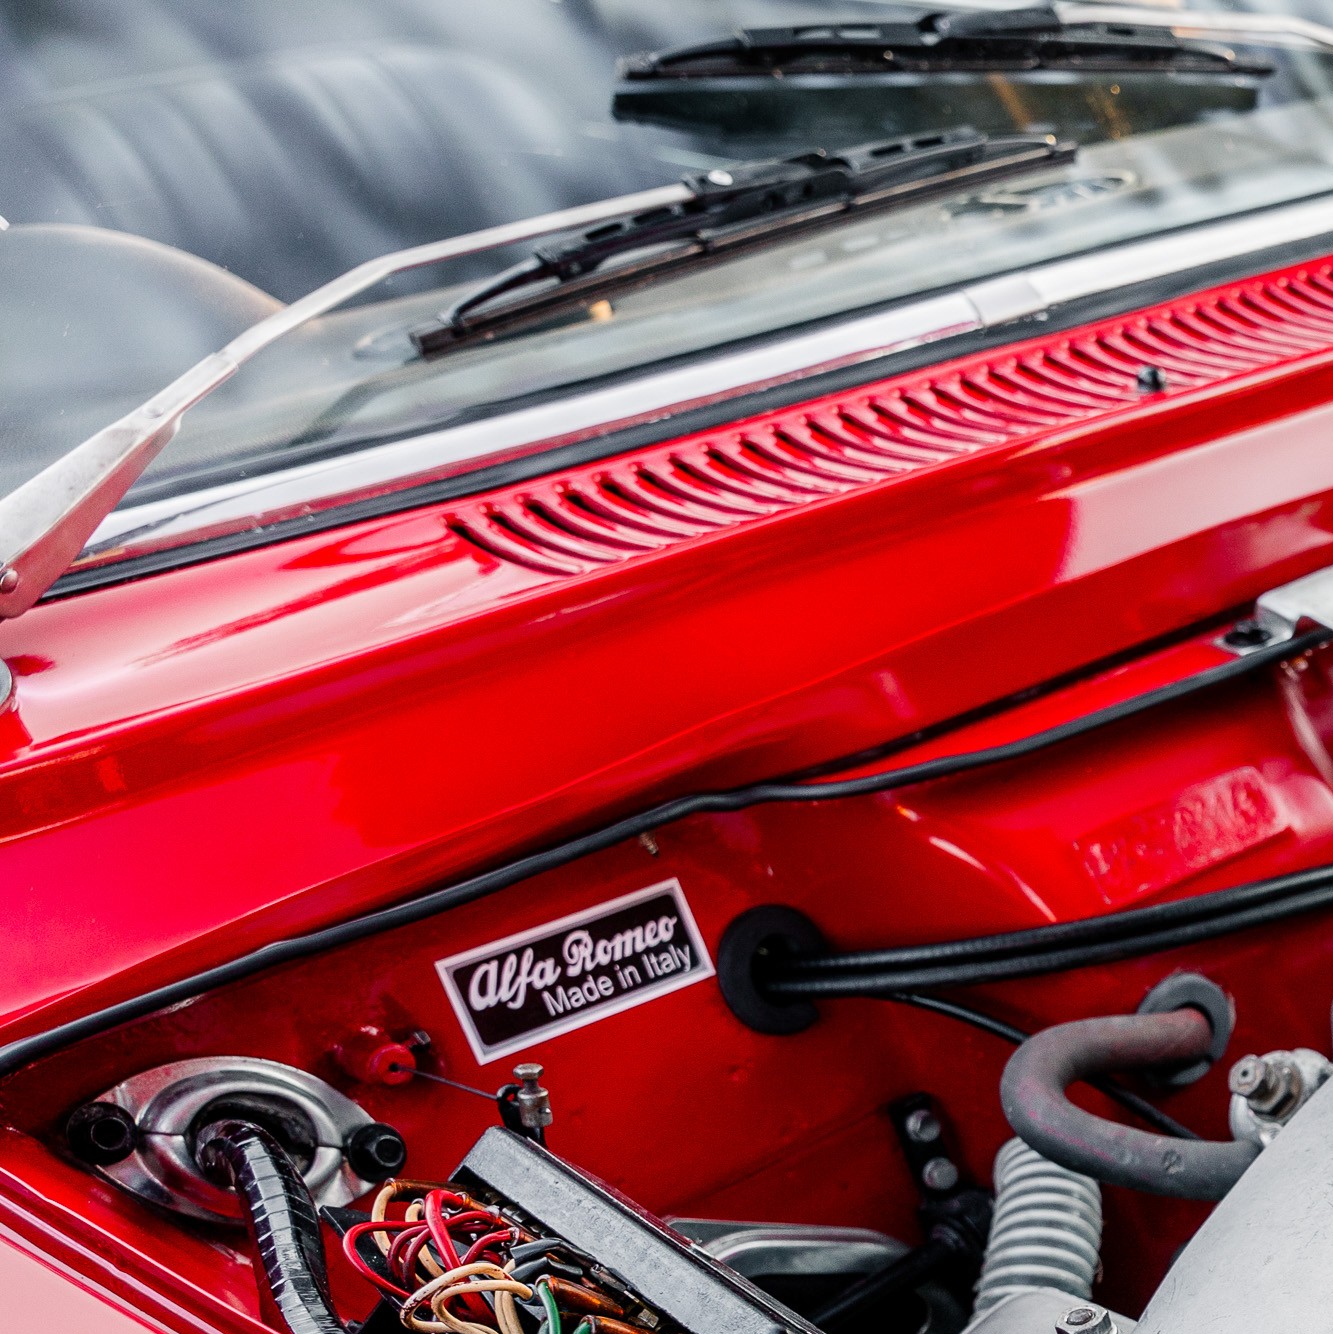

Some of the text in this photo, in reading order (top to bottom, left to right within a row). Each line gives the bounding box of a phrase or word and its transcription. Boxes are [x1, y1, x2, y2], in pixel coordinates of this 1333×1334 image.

[468, 915, 678, 1011] Alfa Romeo
[541, 943, 691, 1017] Made in Italy
